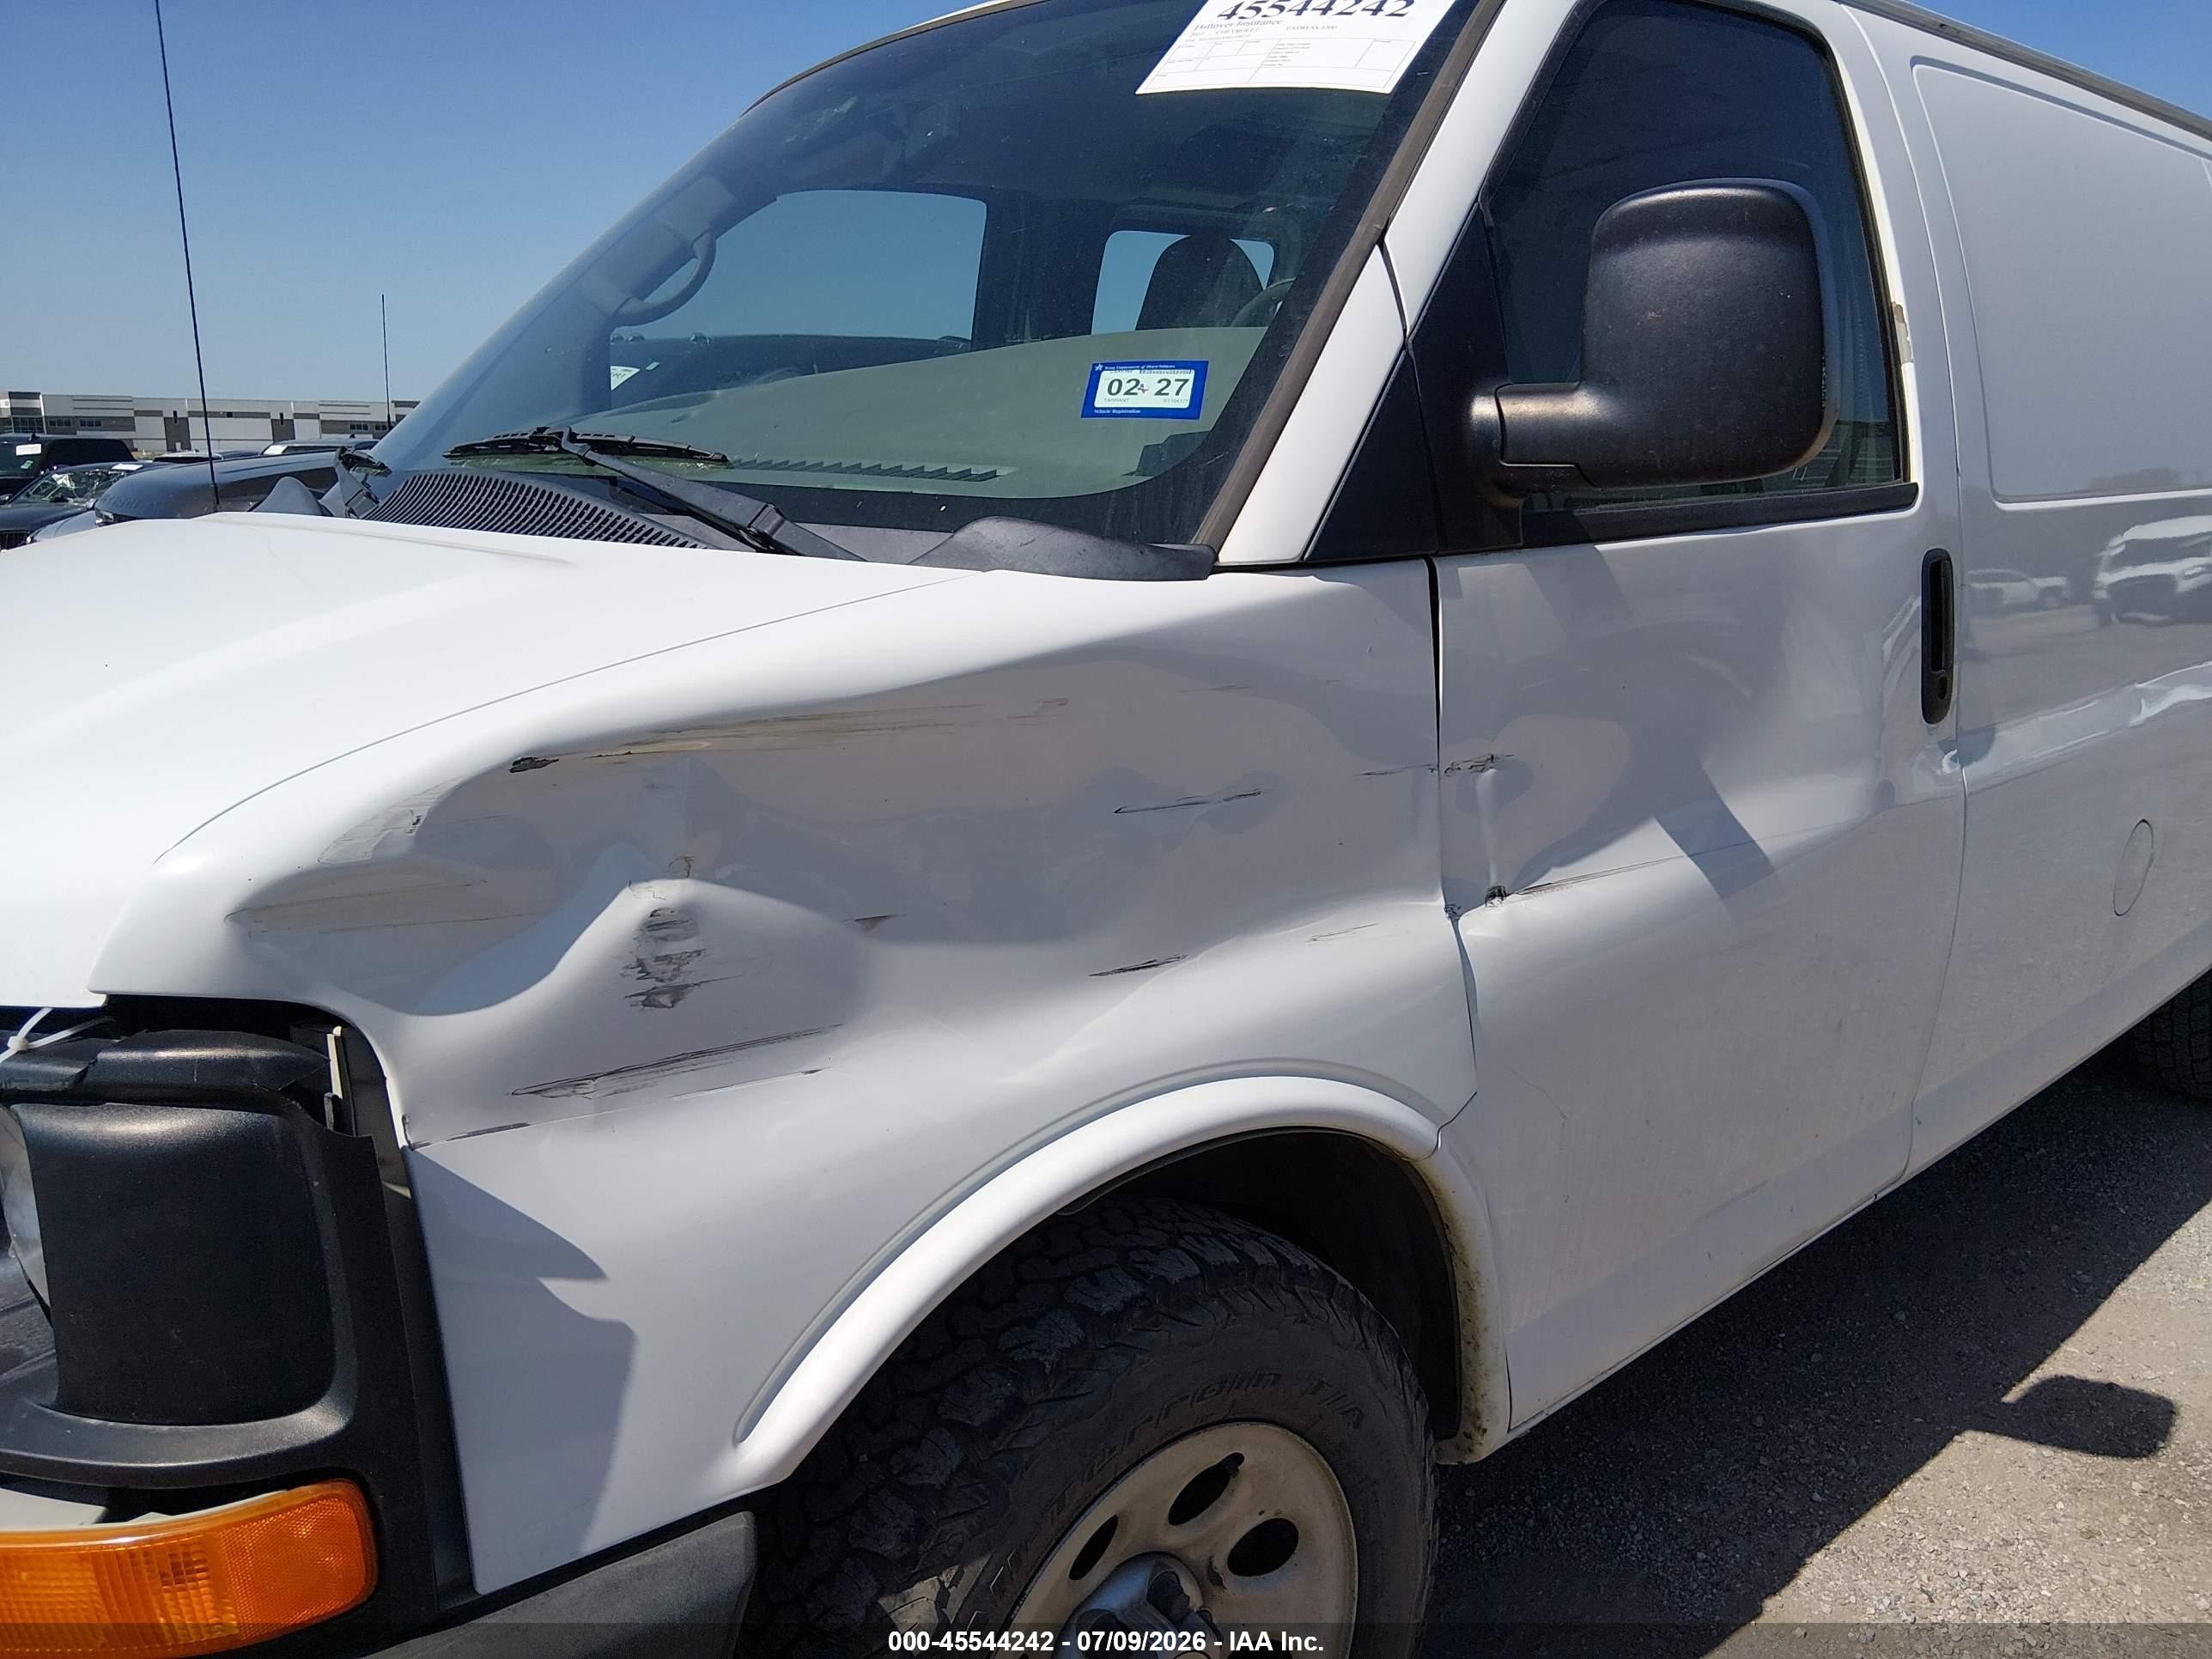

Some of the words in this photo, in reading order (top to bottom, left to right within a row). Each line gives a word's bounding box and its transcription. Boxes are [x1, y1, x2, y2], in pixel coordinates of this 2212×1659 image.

[1217, 0, 1415, 20] 45544242
[1107, 378, 1140, 396] 02
[1153, 378, 1190, 396] 27
